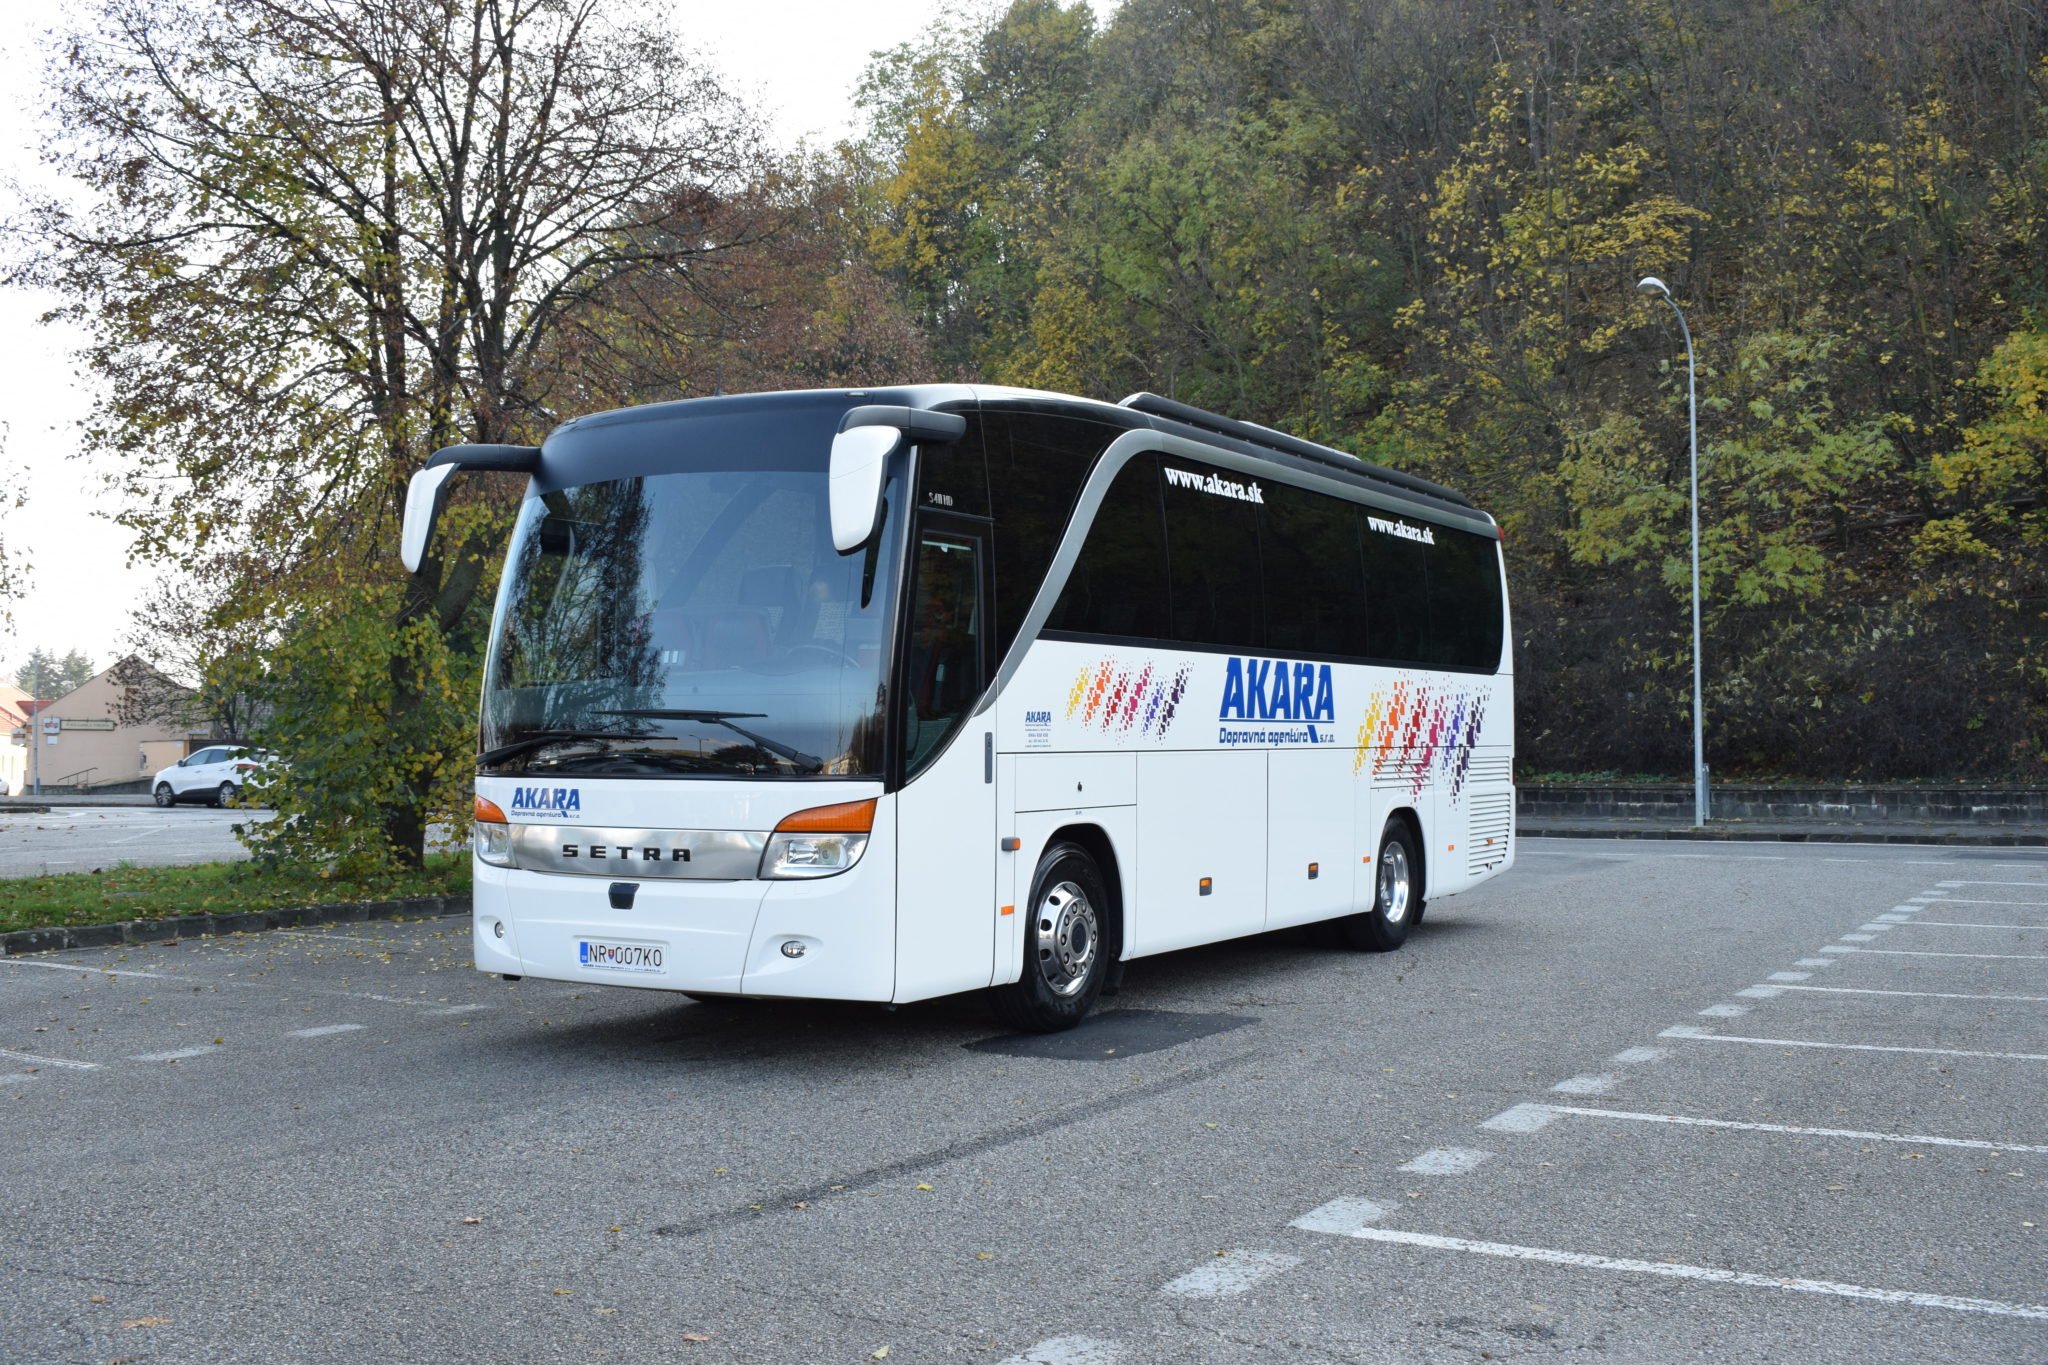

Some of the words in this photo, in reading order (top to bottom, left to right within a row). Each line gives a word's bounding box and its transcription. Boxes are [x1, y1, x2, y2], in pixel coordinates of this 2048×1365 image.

[1164, 467, 1264, 504] www.akara.sk
[1367, 516, 1435, 545] www.akara.sk
[1219, 656, 1335, 721] AKARA
[1025, 711, 1052, 723] AKARA
[1219, 727, 1267, 747] Dopravná
[1267, 727, 1309, 747] agentúra
[511, 787, 581, 810] AKARA
[562, 844, 691, 863] SETRA
